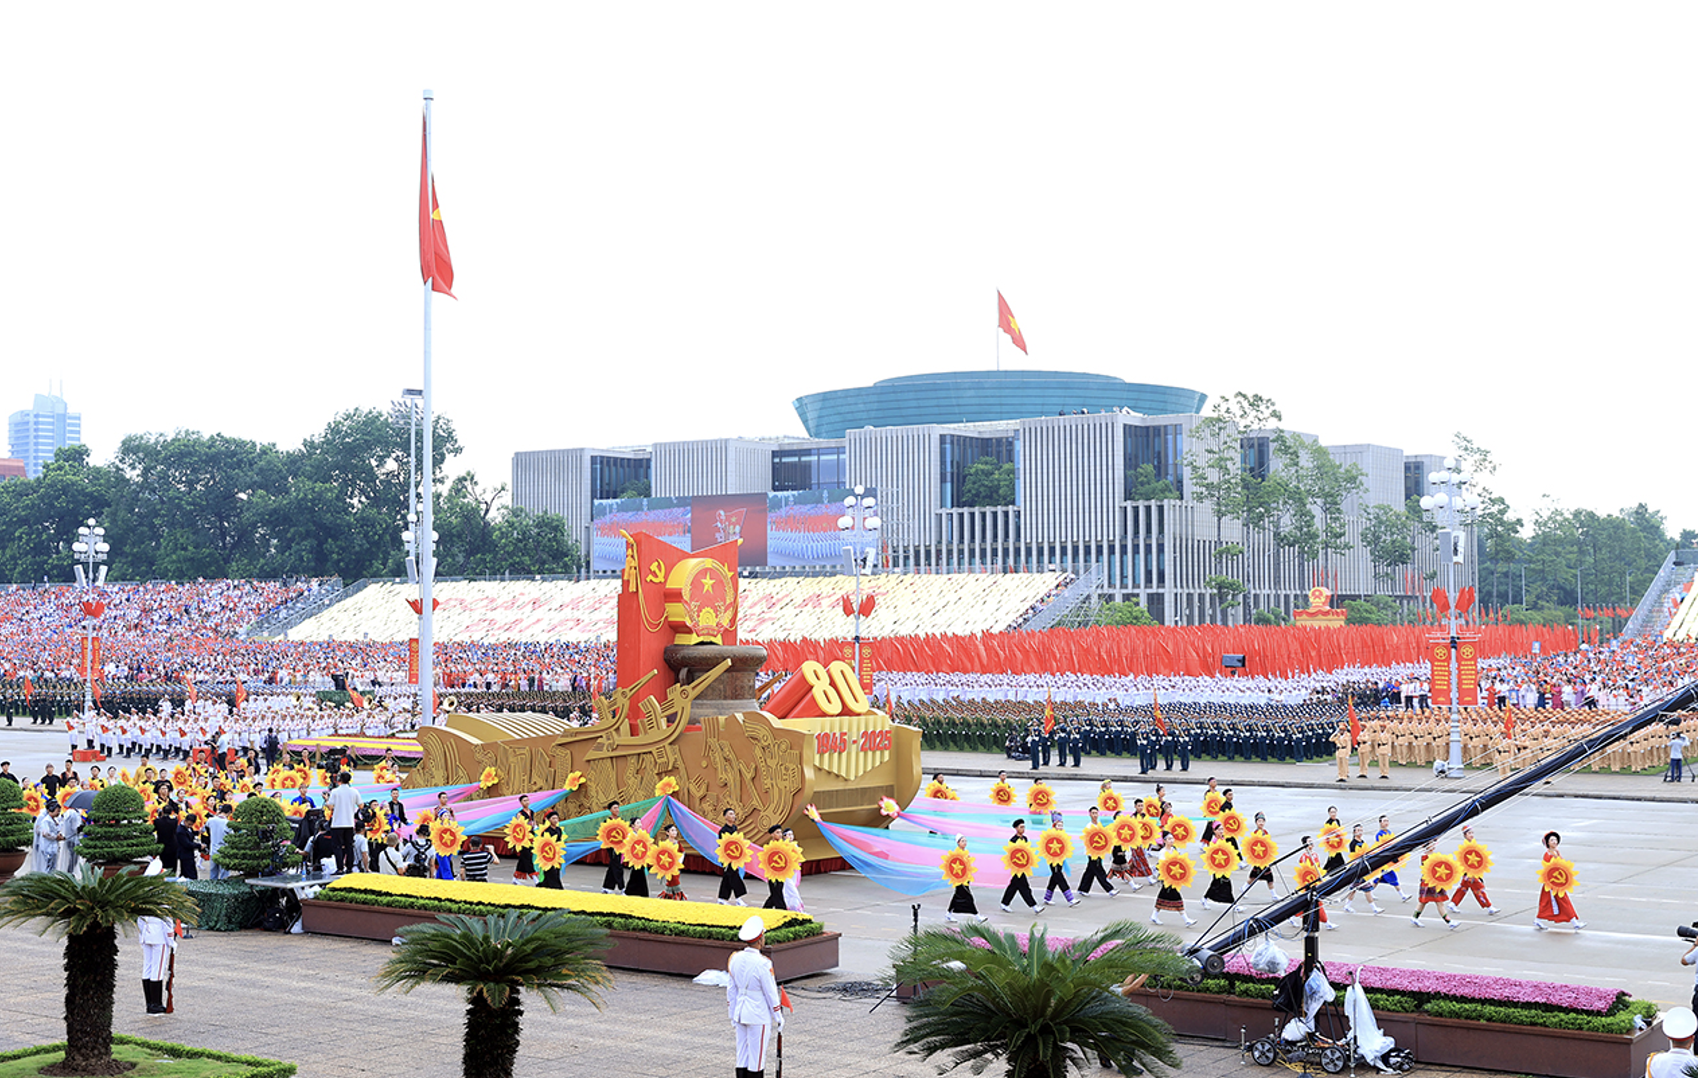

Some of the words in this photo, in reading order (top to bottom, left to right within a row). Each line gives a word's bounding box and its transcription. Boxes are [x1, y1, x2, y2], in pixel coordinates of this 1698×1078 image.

[801, 660, 870, 716] 80
[815, 731, 848, 755] 1945
[860, 729, 892, 753] 2025
